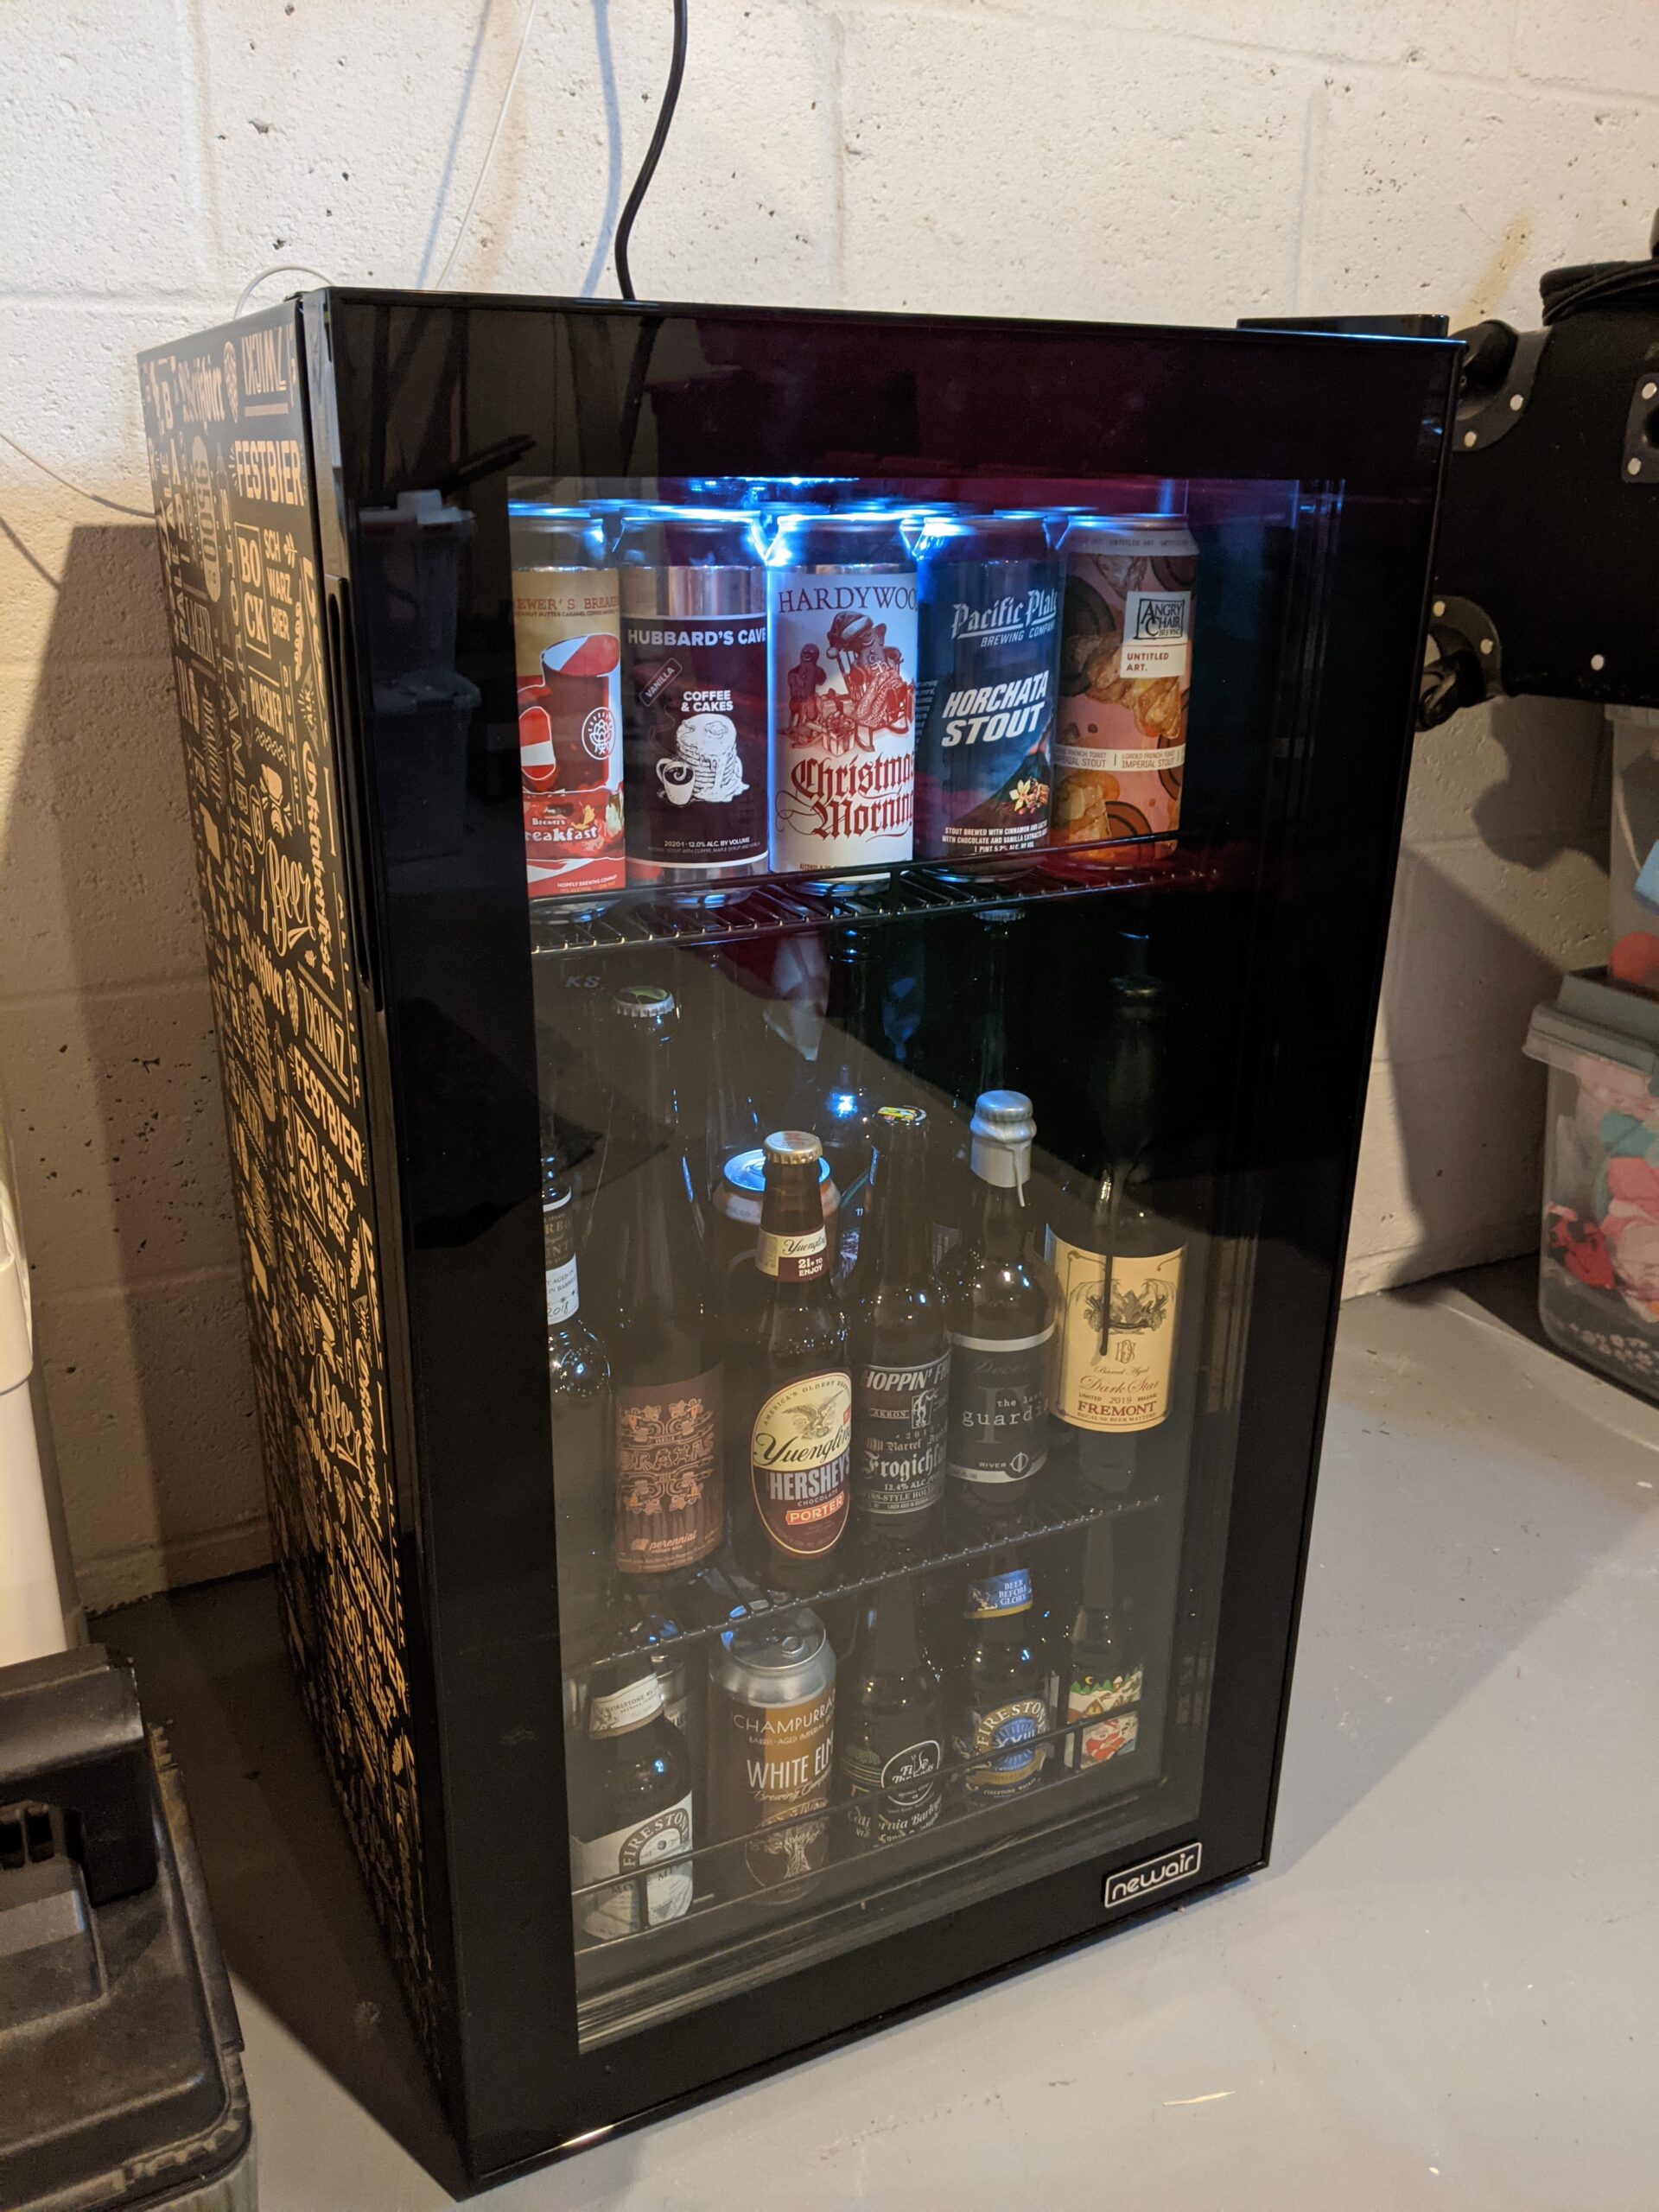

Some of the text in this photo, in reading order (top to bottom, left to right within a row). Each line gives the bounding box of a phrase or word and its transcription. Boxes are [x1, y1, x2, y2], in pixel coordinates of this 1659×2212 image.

[234, 440, 304, 507] FESTBIER
[263, 528, 281, 563] SCH
[266, 567, 293, 605] WARZ
[270, 606, 290, 642] BIER
[951, 595, 1024, 640] Pacific
[1141, 601, 1183, 625] ANGRY
[627, 627, 766, 646] HUBBARD'S CAVE
[1145, 616, 1182, 637] CHAIR
[980, 630, 1025, 648] BREWING
[1126, 663, 1148, 671] ART.
[1127, 652, 1169, 661] UNTITLED
[645, 666, 676, 698] VANILLA
[683, 690, 731, 702] COFFEE
[941, 669, 1050, 720] HORCHATA
[249, 676, 284, 737] PILSENER
[680, 701, 734, 713] & CAKES
[940, 702, 1046, 748] STOUT
[282, 663, 302, 828] DUNKEL
[1083, 759, 1107, 767] STOUT
[1122, 760, 1155, 768] IMPERIAL
[728, 836, 751, 846] VOLUME
[942, 835, 957, 843] WITH
[1003, 835, 1024, 843] VANILLA
[300, 736, 336, 995] Oktoberfest
[262, 826, 321, 1007] Beer
[299, 976, 349, 1090] ZWICKL
[295, 1046, 365, 1187] FESTBIER
[798, 1263, 823, 1277] ENJOY
[815, 1257, 823, 1266] TO
[1078, 1375, 1125, 1394] Dark
[763, 1379, 836, 1427] AMERICA'S OLDEST
[996, 1398, 1017, 1408] the
[1077, 1392, 1103, 1402] LIMITED
[1108, 1395, 1133, 1404] 2019
[1077, 1400, 1158, 1417] FREMONT
[873, 1409, 907, 1419] AKRON
[797, 1488, 839, 1507] CHOCOLATE
[789, 1496, 844, 1523] PORTER
[649, 1529, 696, 1552] perennial
[1003, 1579, 1023, 1591] BEER
[1000, 1592, 1027, 1605] GLORY
[976, 1701, 1046, 1746] FIRESTONE
[746, 1754, 809, 1789] WHITE
[623, 1811, 689, 1866] FIRESTONE
[1111, 1853, 1195, 1900] newair
